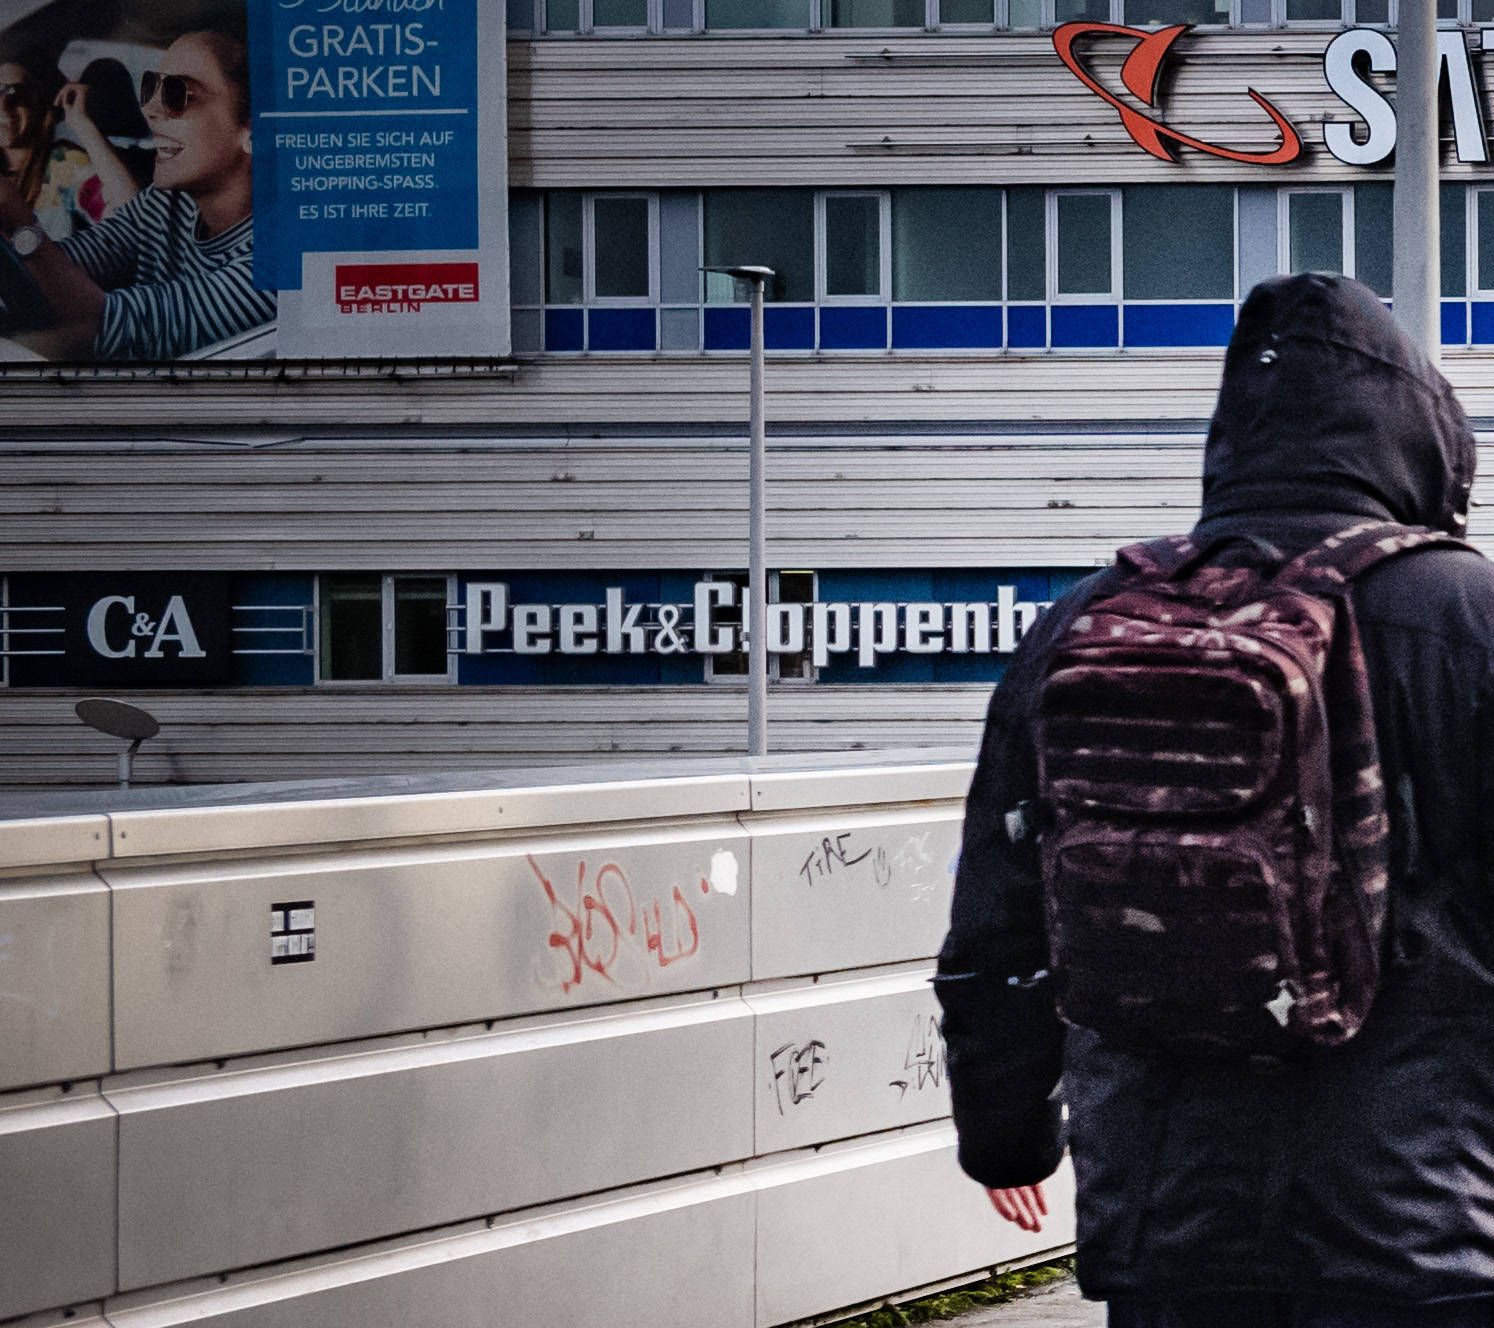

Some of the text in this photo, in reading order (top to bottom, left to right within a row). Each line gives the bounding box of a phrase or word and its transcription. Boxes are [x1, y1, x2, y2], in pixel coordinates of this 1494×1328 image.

[288, 23, 438, 58] GRATIS-
[287, 64, 441, 99] PARKEN
[275, 131, 454, 148] FREUEN SIE SICH AUF
[295, 153, 435, 170] UNGEBREMSTEN
[299, 205, 318, 220] ES
[324, 204, 347, 219] IST
[351, 203, 388, 218] IHRE
[340, 283, 475, 301] EASTGATE
[340, 301, 421, 314] BERLIN
[87, 595, 207, 658] C&A
